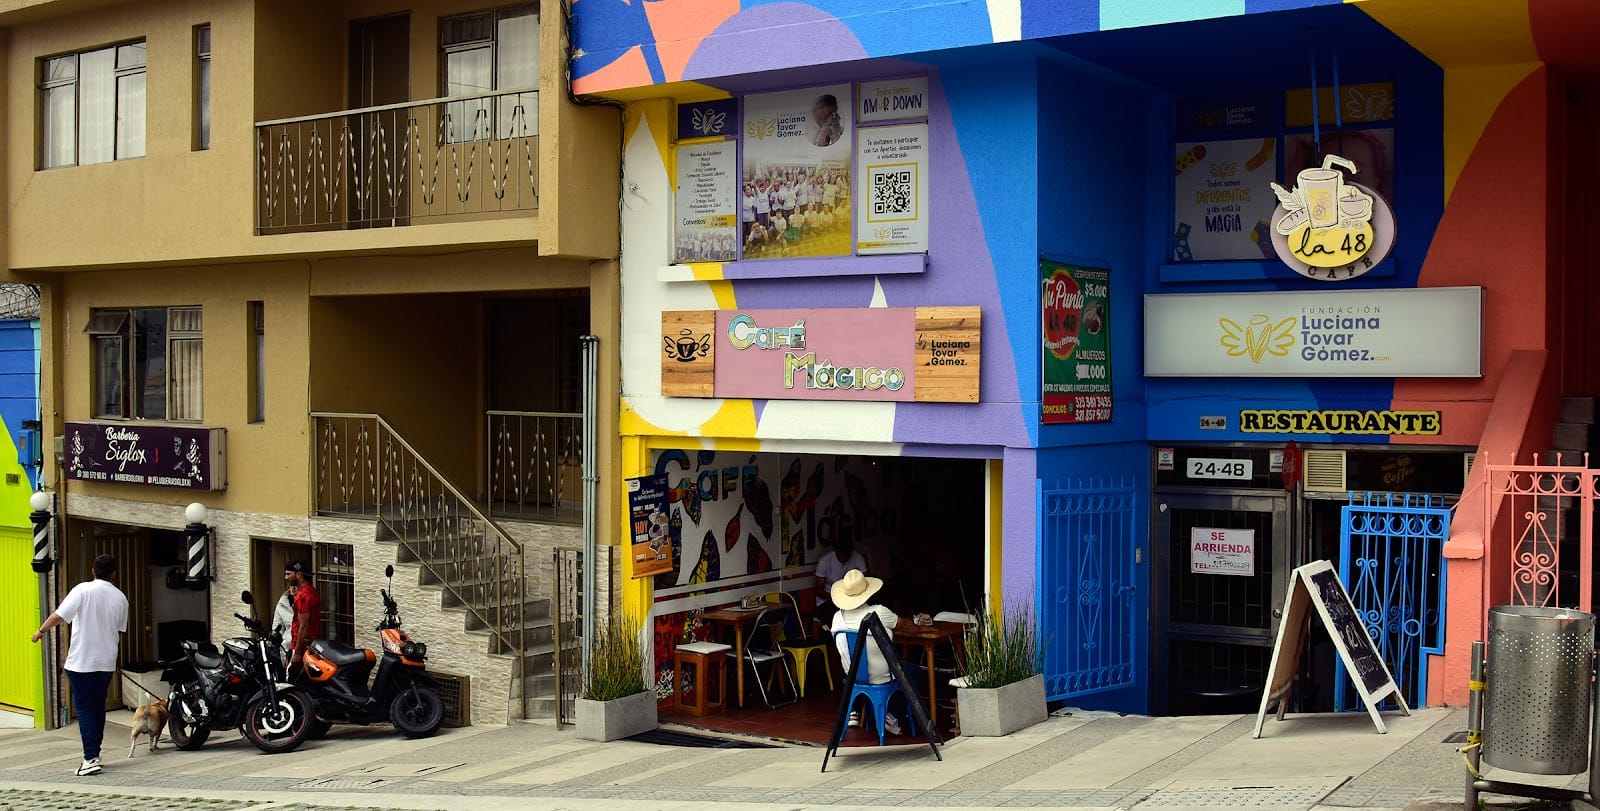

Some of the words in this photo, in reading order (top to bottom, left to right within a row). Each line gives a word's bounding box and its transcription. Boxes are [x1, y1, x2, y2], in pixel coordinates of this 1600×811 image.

[893, 93, 923, 111] DOWN
[777, 116, 806, 124] Luciana
[1294, 226, 1335, 257] la
[1340, 233, 1367, 256] 48
[1055, 279, 1084, 311] Punto
[1301, 305, 1381, 314] FUNDACIÓN
[1301, 314, 1380, 331] Luciana
[931, 339, 971, 349] Luciana
[1301, 331, 1354, 346] Tovar
[931, 348, 958, 357] Tovar
[1075, 349, 1106, 361] ALMUERZOS
[1240, 410, 1440, 434] RESTAURANTE
[634, 520, 649, 535] HOY
[1211, 532, 1225, 541] SE
[1194, 542, 1252, 555] ARRIENDA
